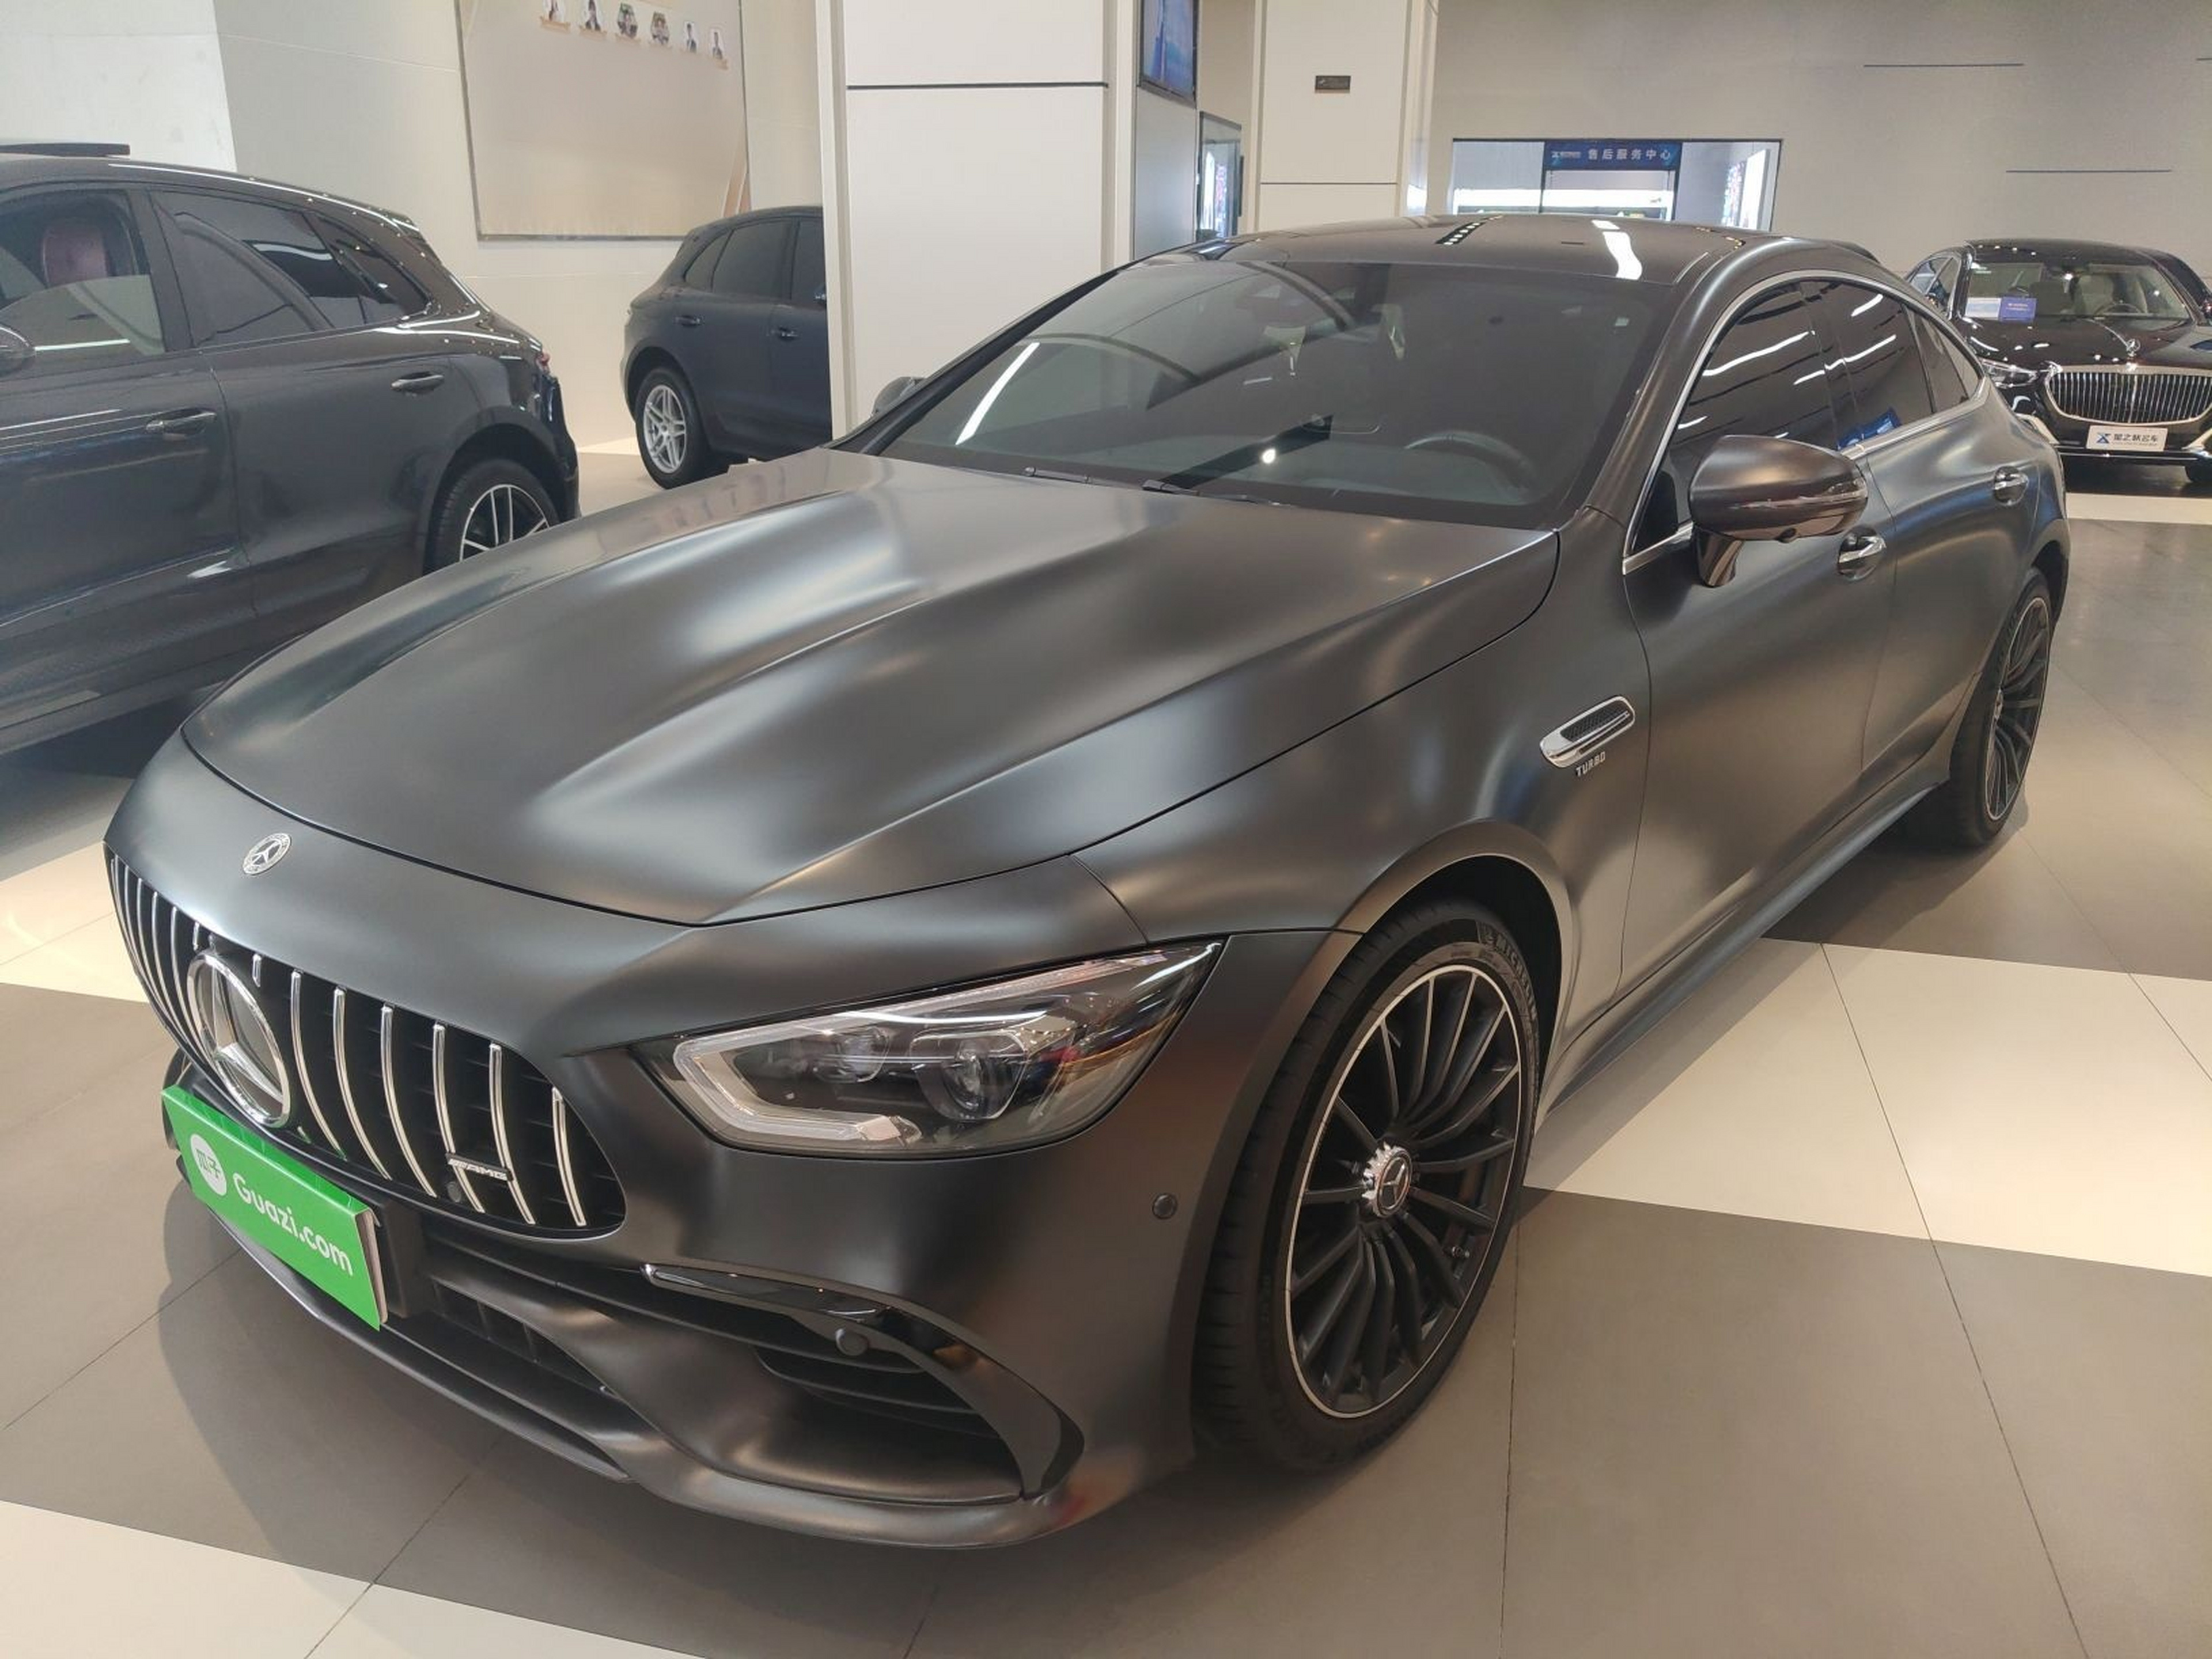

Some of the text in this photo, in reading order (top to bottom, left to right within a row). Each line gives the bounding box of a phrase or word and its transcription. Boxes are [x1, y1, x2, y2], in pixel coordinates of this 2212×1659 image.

[1588, 148, 1671, 160] 售后服务中心
[1575, 751, 1606, 777] TURBO
[466, 1164, 507, 1181] AMG
[232, 1172, 354, 1277] Guazi.com
